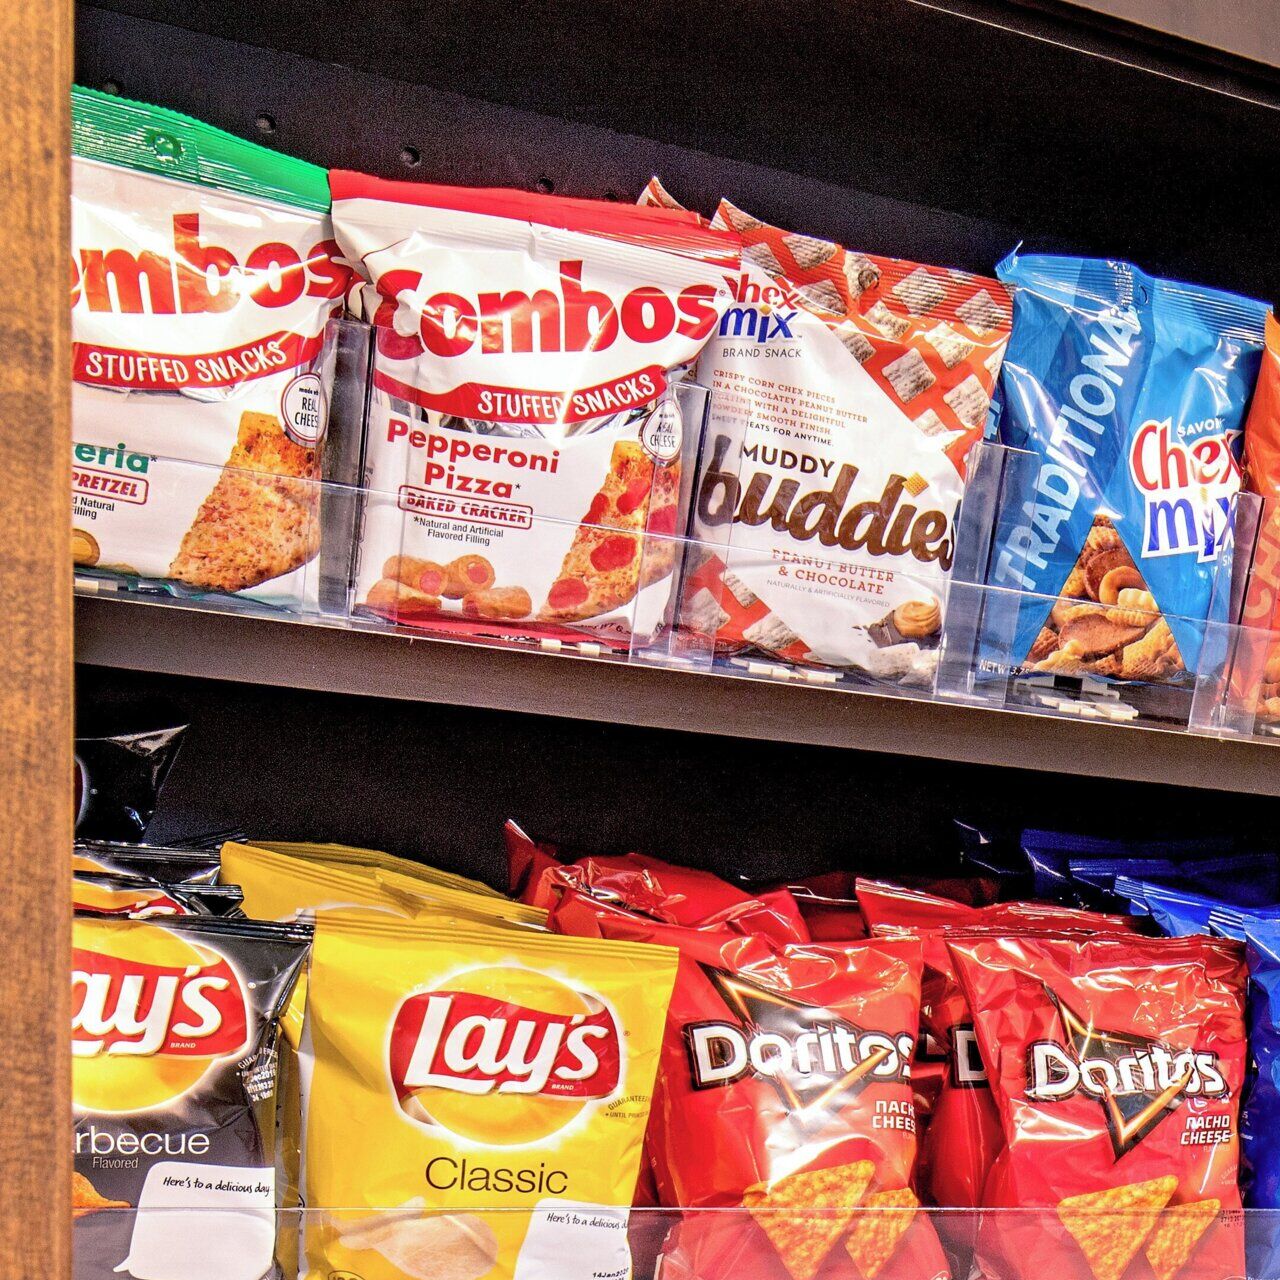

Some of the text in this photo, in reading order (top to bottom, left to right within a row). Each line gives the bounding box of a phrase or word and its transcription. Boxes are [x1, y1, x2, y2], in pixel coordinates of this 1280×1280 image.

[376, 260, 719, 358] Combos
[719, 304, 797, 343] mix
[86, 342, 287, 384] STUFFED SNACKS
[723, 347, 802, 359] BRAND SNACK
[478, 380, 656, 419] STUFFED SNACKS
[714, 370, 835, 403] CRISPY CORN CHEX PIECES
[387, 419, 559, 474] Pepperoni
[742, 445, 835, 478] MUDDY
[407, 492, 527, 524] BAKED CRACKER
[428, 528, 490, 546] Flavored Filling
[772, 549, 894, 583] PEANUT BUTTER
[778, 566, 884, 595] & CHOCOLATE
[403, 995, 611, 1097] Lay's
[692, 1022, 915, 1091] Doritos
[551, 1083, 575, 1091] BRAND
[1032, 1041, 1228, 1101] Doritos
[1181, 1129, 1231, 1145] CHEESE
[1186, 1115, 1230, 1129] NACHO
[92, 1157, 139, 1170] Flavored
[425, 1157, 570, 1195] Classic
